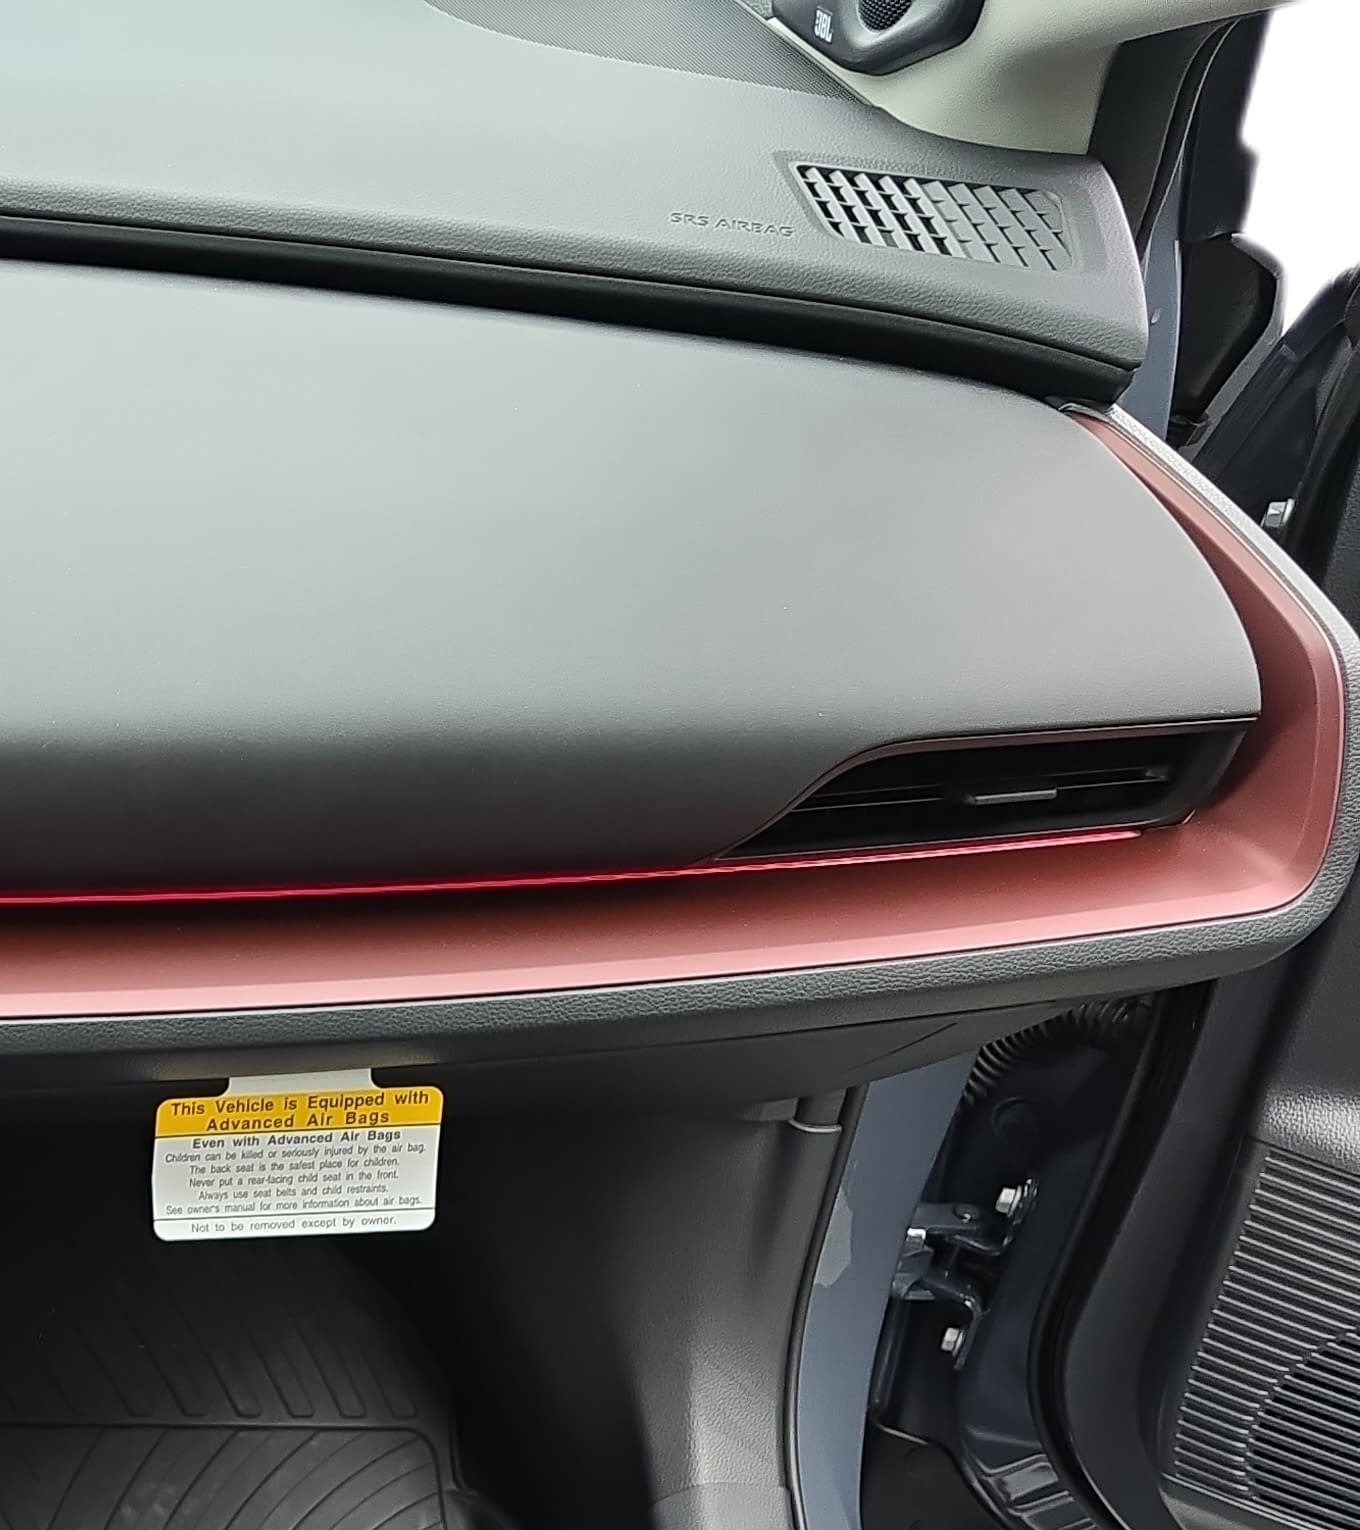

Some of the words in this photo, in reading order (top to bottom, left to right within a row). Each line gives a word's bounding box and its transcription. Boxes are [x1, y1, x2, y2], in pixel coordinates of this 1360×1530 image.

[814, 10, 832, 42] JBL
[670, 212, 709, 227] SRS
[714, 218, 794, 237] AIRBAG
[172, 1102, 205, 1116] This
[216, 1098, 274, 1113] Vehicle
[284, 1097, 297, 1110] is
[308, 1092, 384, 1111] Equipped
[395, 1090, 429, 1104] with
[206, 1115, 294, 1131] Advanced
[307, 1113, 332, 1126] Air
[346, 1111, 390, 1125] Bags
[192, 1138, 225, 1149] Even
[232, 1136, 260, 1147] with
[267, 1132, 333, 1146] Advanced
[340, 1132, 360, 1142] Air
[367, 1130, 401, 1142] Bags
[166, 1153, 200, 1163] Children
[205, 1153, 221, 1161] can
[226, 1151, 236, 1160] be
[241, 1150, 264, 1159] killed
[268, 1150, 277, 1158] or
[282, 1146, 320, 1158] seriously
[324, 1146, 353, 1157] injured
[358, 1144, 368, 1155] by
[373, 1144, 386, 1153] the
[392, 1144, 403, 1153] air
[190, 1165, 206, 1174] The
[210, 1164, 231, 1174] back
[236, 1164, 254, 1172] seat
[259, 1163, 266, 1171] is
[271, 1162, 284, 1171] the
[290, 1160, 315, 1170] safest
[320, 1160, 342, 1171] place
[348, 1158, 359, 1167] for
[190, 1178, 215, 1188] Never
[219, 1178, 233, 1188] put
[238, 1178, 243, 1186] a
[248, 1175, 294, 1186] rear-facing
[298, 1173, 318, 1182] child
[323, 1172, 341, 1182] seat
[346, 1172, 354, 1180] in
[358, 1171, 372, 1180] the
[198, 1191, 228, 1201] Always
[233, 1190, 248, 1198] use
[254, 1188, 272, 1198] seat
[276, 1188, 296, 1196] belts
[301, 1186, 318, 1196] and
[322, 1185, 342, 1194] child
[166, 1206, 182, 1215] See
[224, 1202, 255, 1212] manual
[260, 1202, 271, 1210] for
[276, 1201, 298, 1210] more
[302, 1198, 349, 1209] information
[354, 1197, 378, 1207] about
[383, 1196, 394, 1206] air
[192, 1223, 209, 1233] Not
[215, 1223, 225, 1232] to
[232, 1222, 244, 1231] be
[250, 1220, 295, 1230] removed
[302, 1218, 336, 1228] except
[342, 1217, 355, 1228] by
[361, 1216, 396, 1226] owner.
